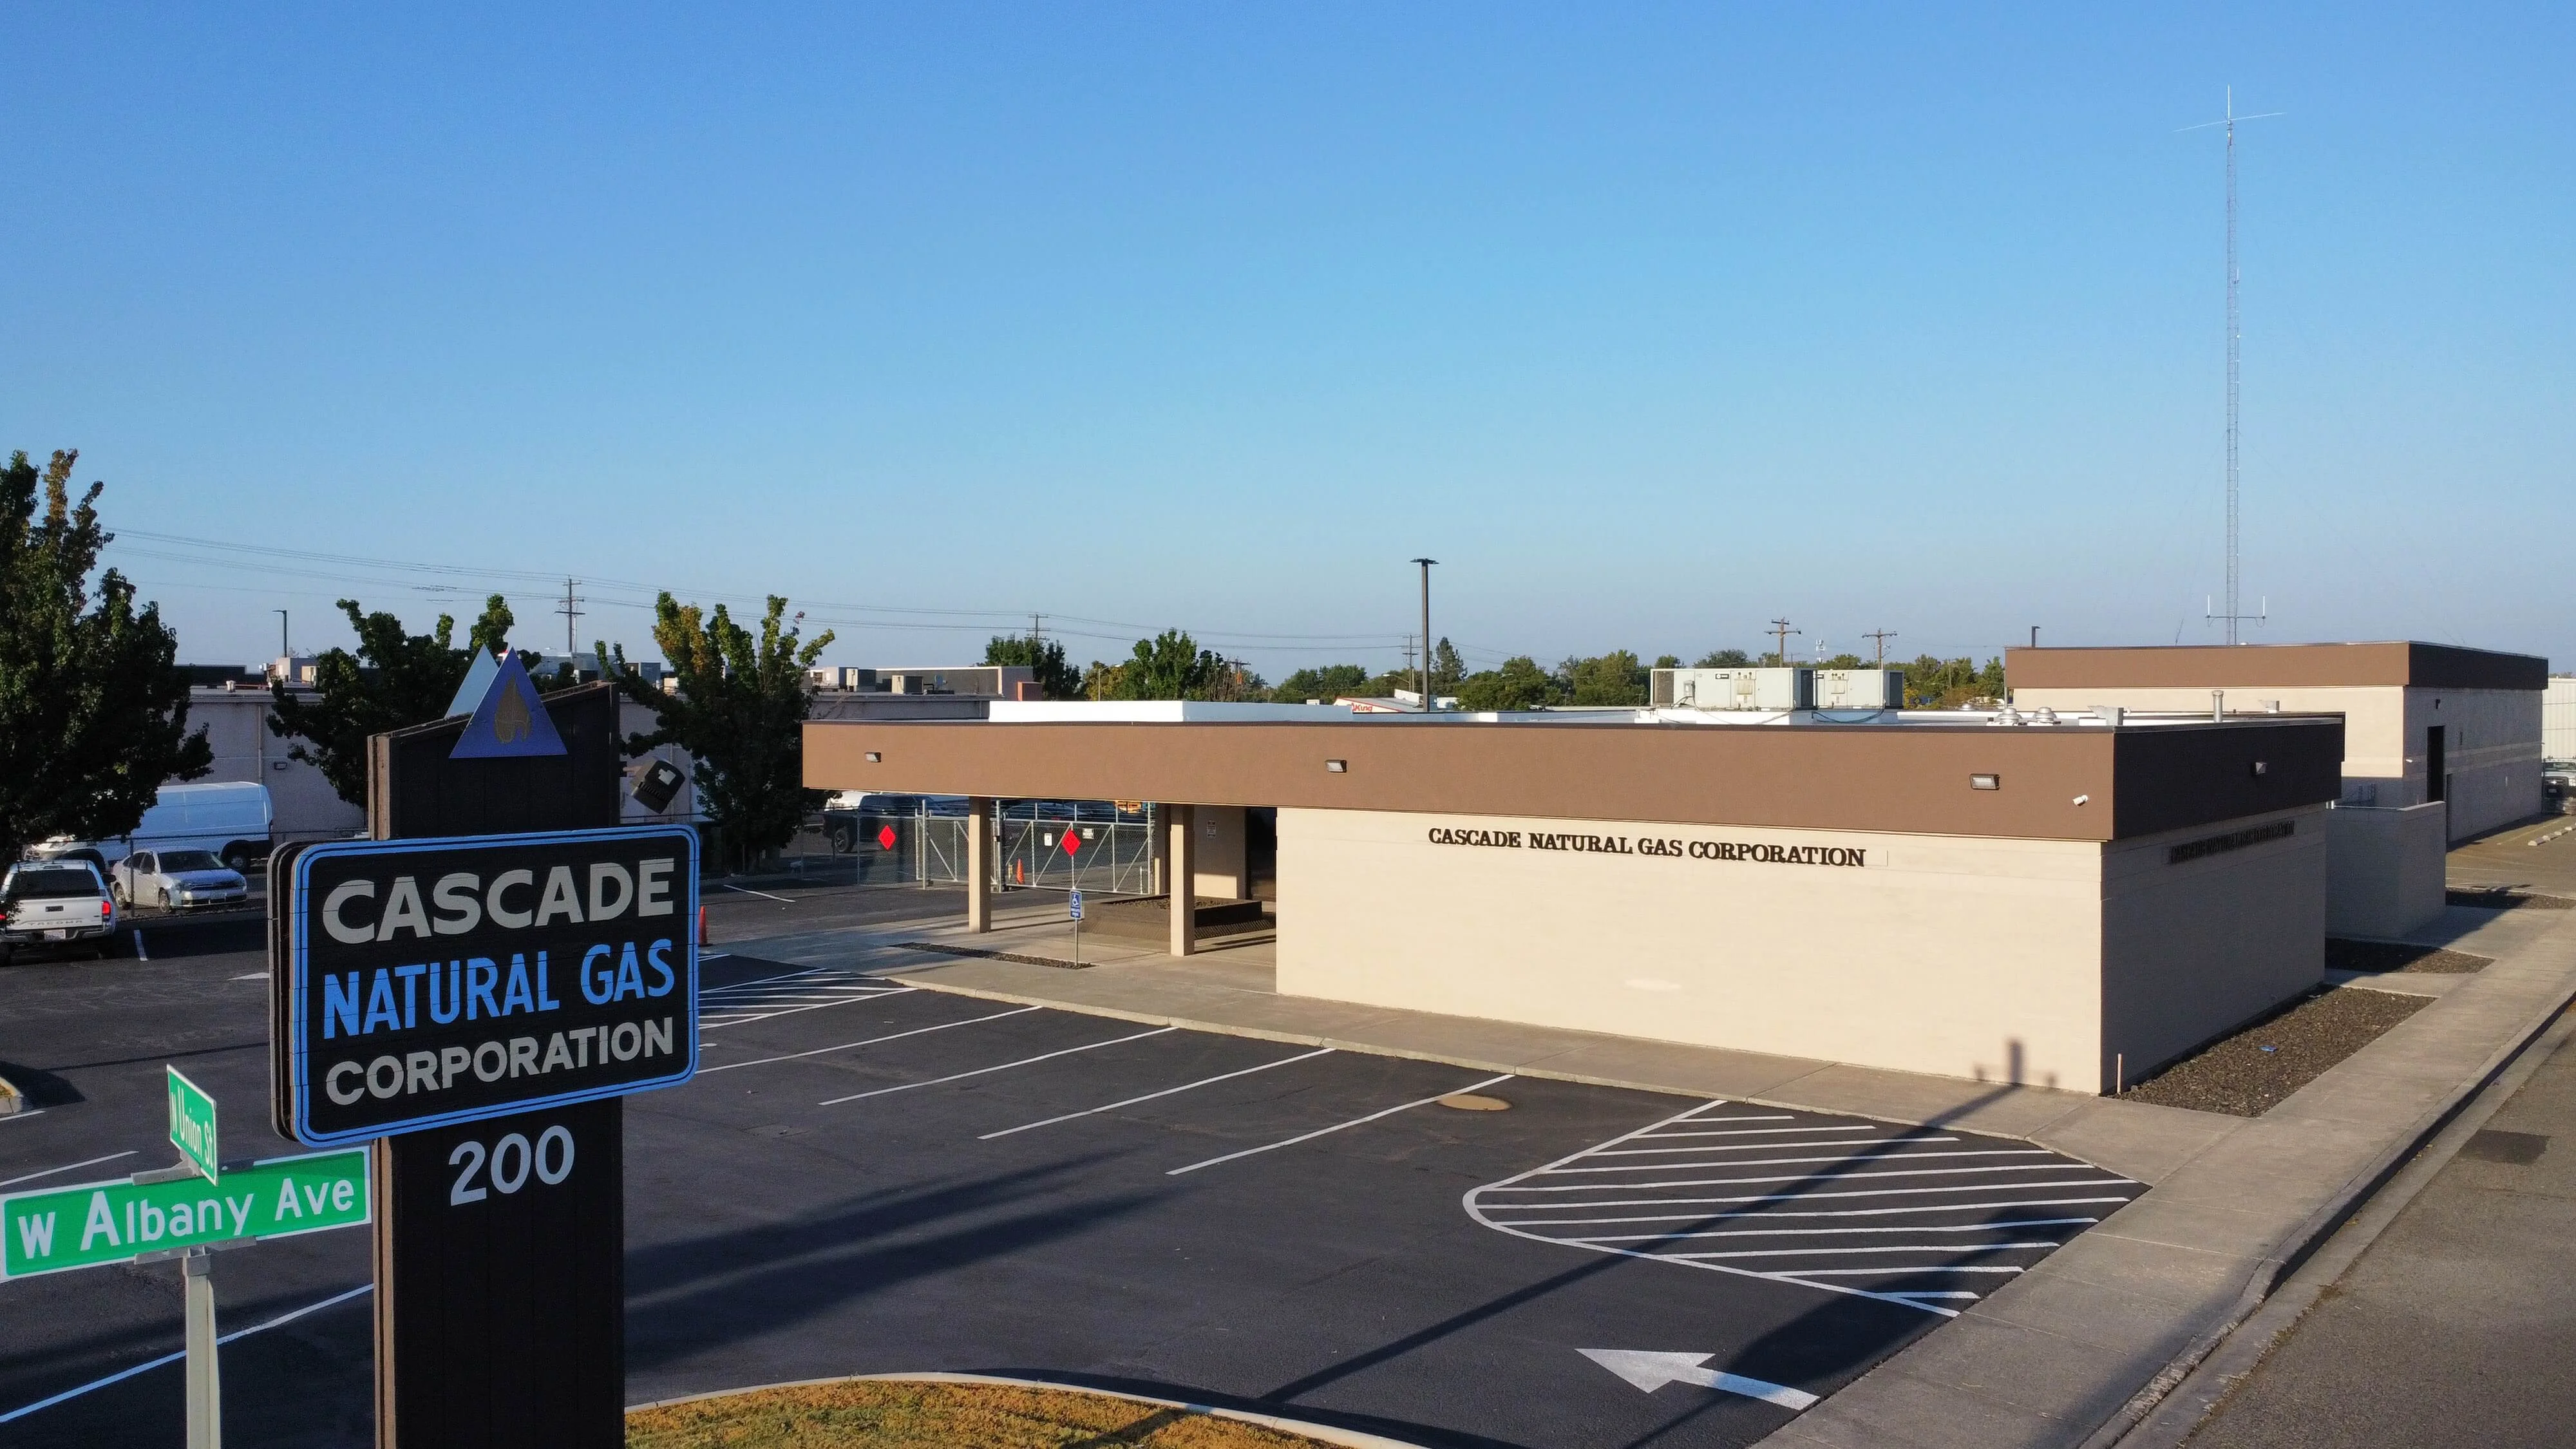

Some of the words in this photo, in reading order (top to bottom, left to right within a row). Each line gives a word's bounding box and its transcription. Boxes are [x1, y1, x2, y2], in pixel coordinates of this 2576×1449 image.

[1428, 828, 1522, 848] CASCADE
[1528, 833, 1634, 855] NATURAL
[1638, 838, 1683, 857] GAS
[1689, 841, 1866, 867] CORPORATION
[322, 858, 674, 944] CASCADE
[324, 951, 561, 1039] NATURAL
[581, 938, 676, 1005] GAS
[325, 1017, 673, 1106] CORPORATION
[178, 1084, 202, 1158] Union
[204, 1120, 213, 1169] St
[448, 1125, 574, 1207] 200
[17, 1212, 55, 1259] W
[80, 1191, 254, 1251] Albany
[275, 1178, 355, 1221] Ave
